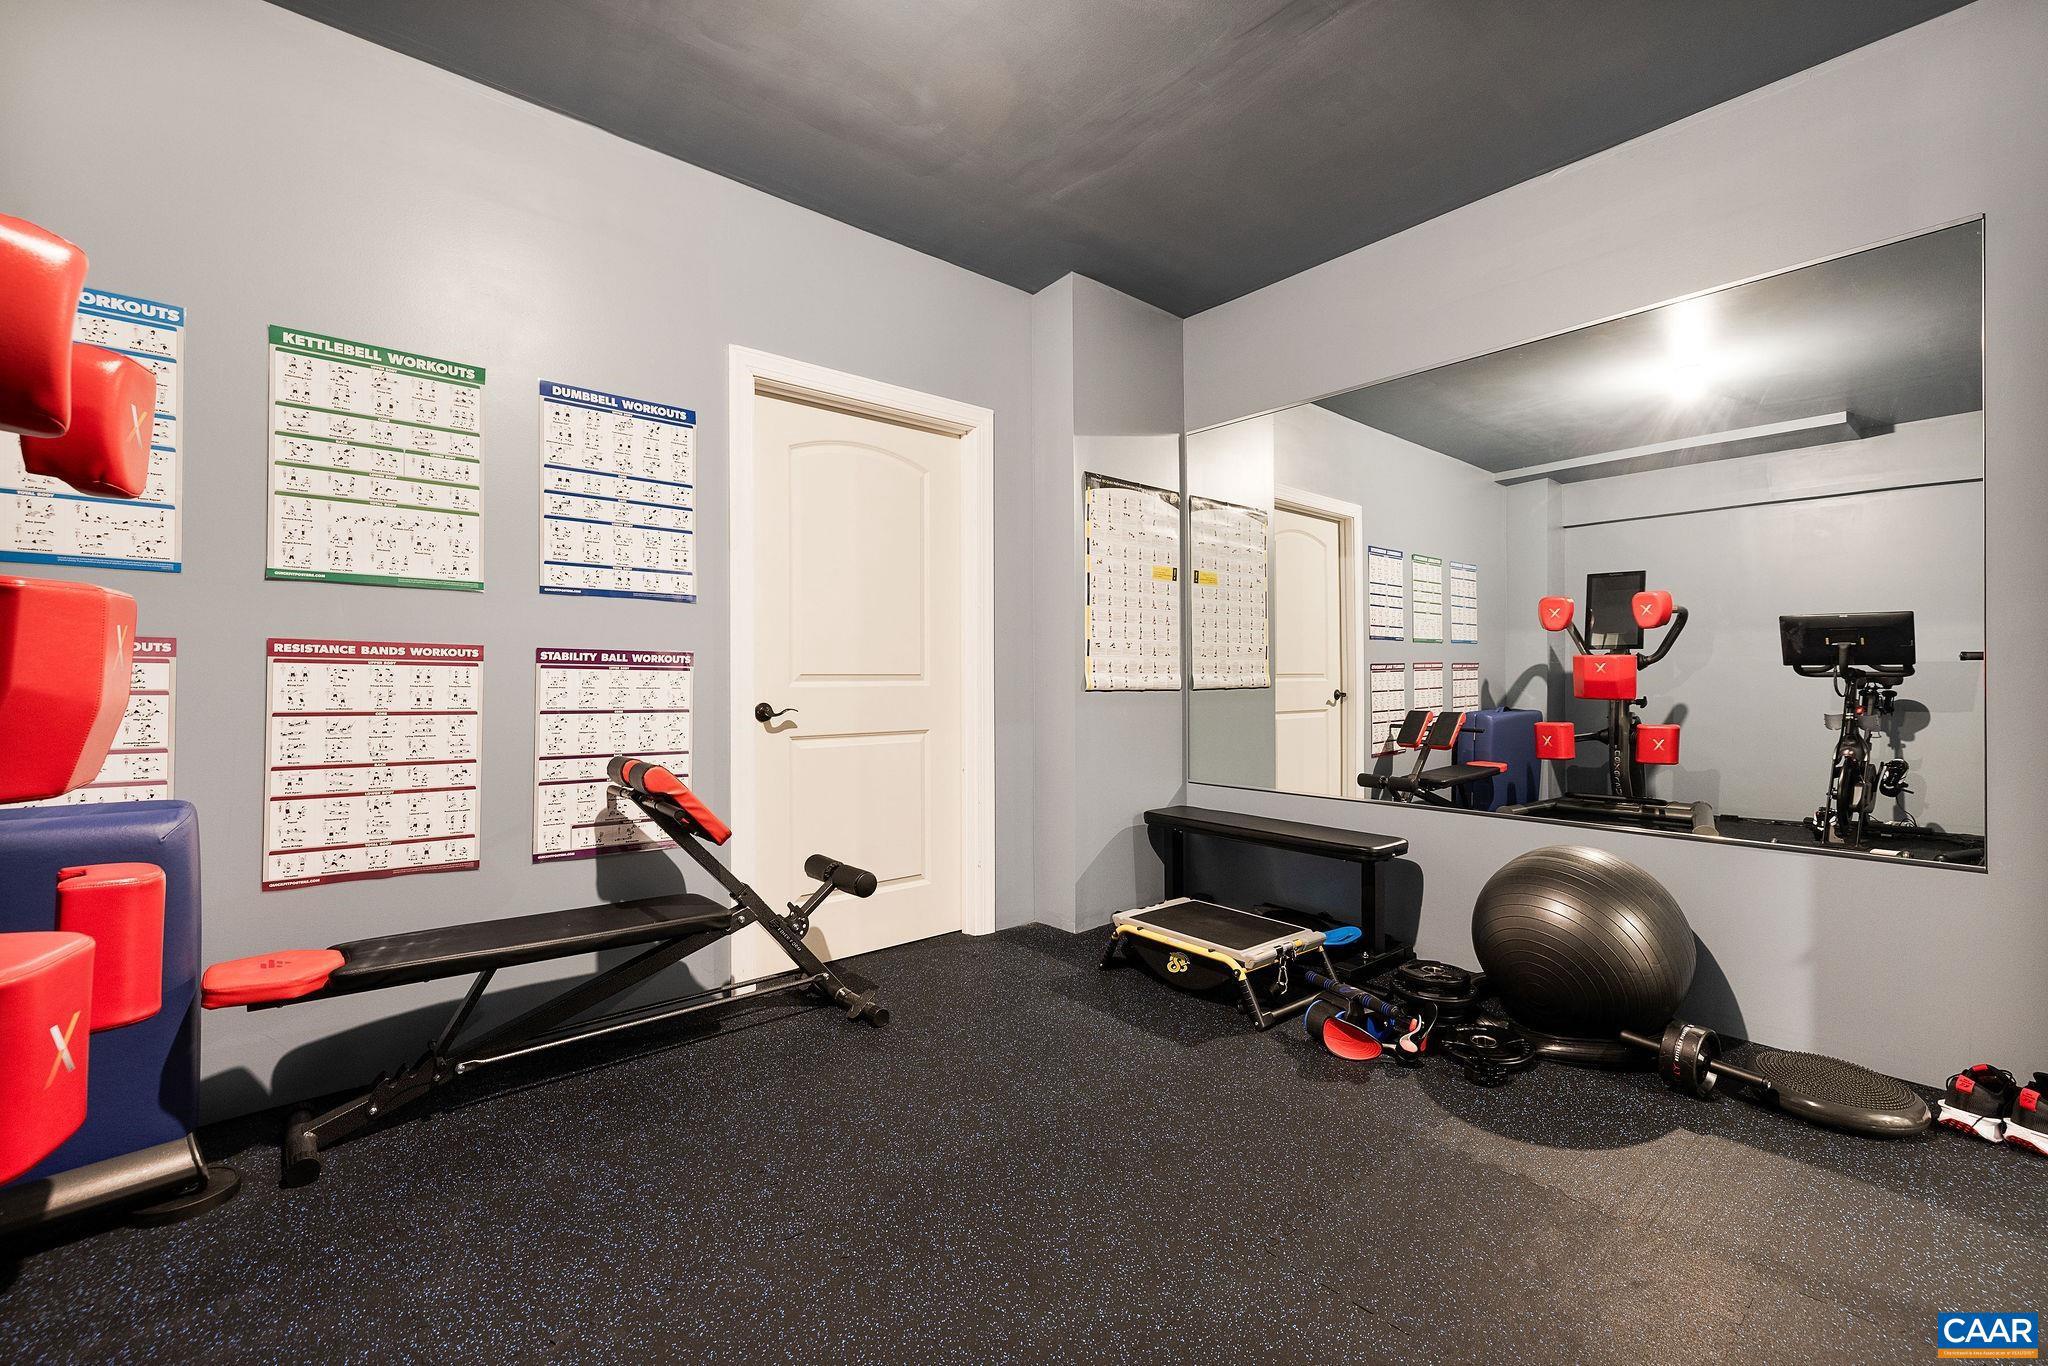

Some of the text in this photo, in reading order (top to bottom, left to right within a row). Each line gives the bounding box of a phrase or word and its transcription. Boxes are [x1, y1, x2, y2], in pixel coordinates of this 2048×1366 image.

[79, 291, 180, 322] ORKOUTS
[282, 332, 475, 379] KETTLEBELL WORKOUTS
[552, 386, 687, 420] DUMBBELL WORKOUTS
[133, 642, 172, 652] OUTS
[274, 643, 479, 658] RESISTANCE BANDS WORKOUTS
[540, 651, 691, 664] STABILITY BALL WORKOUTS
